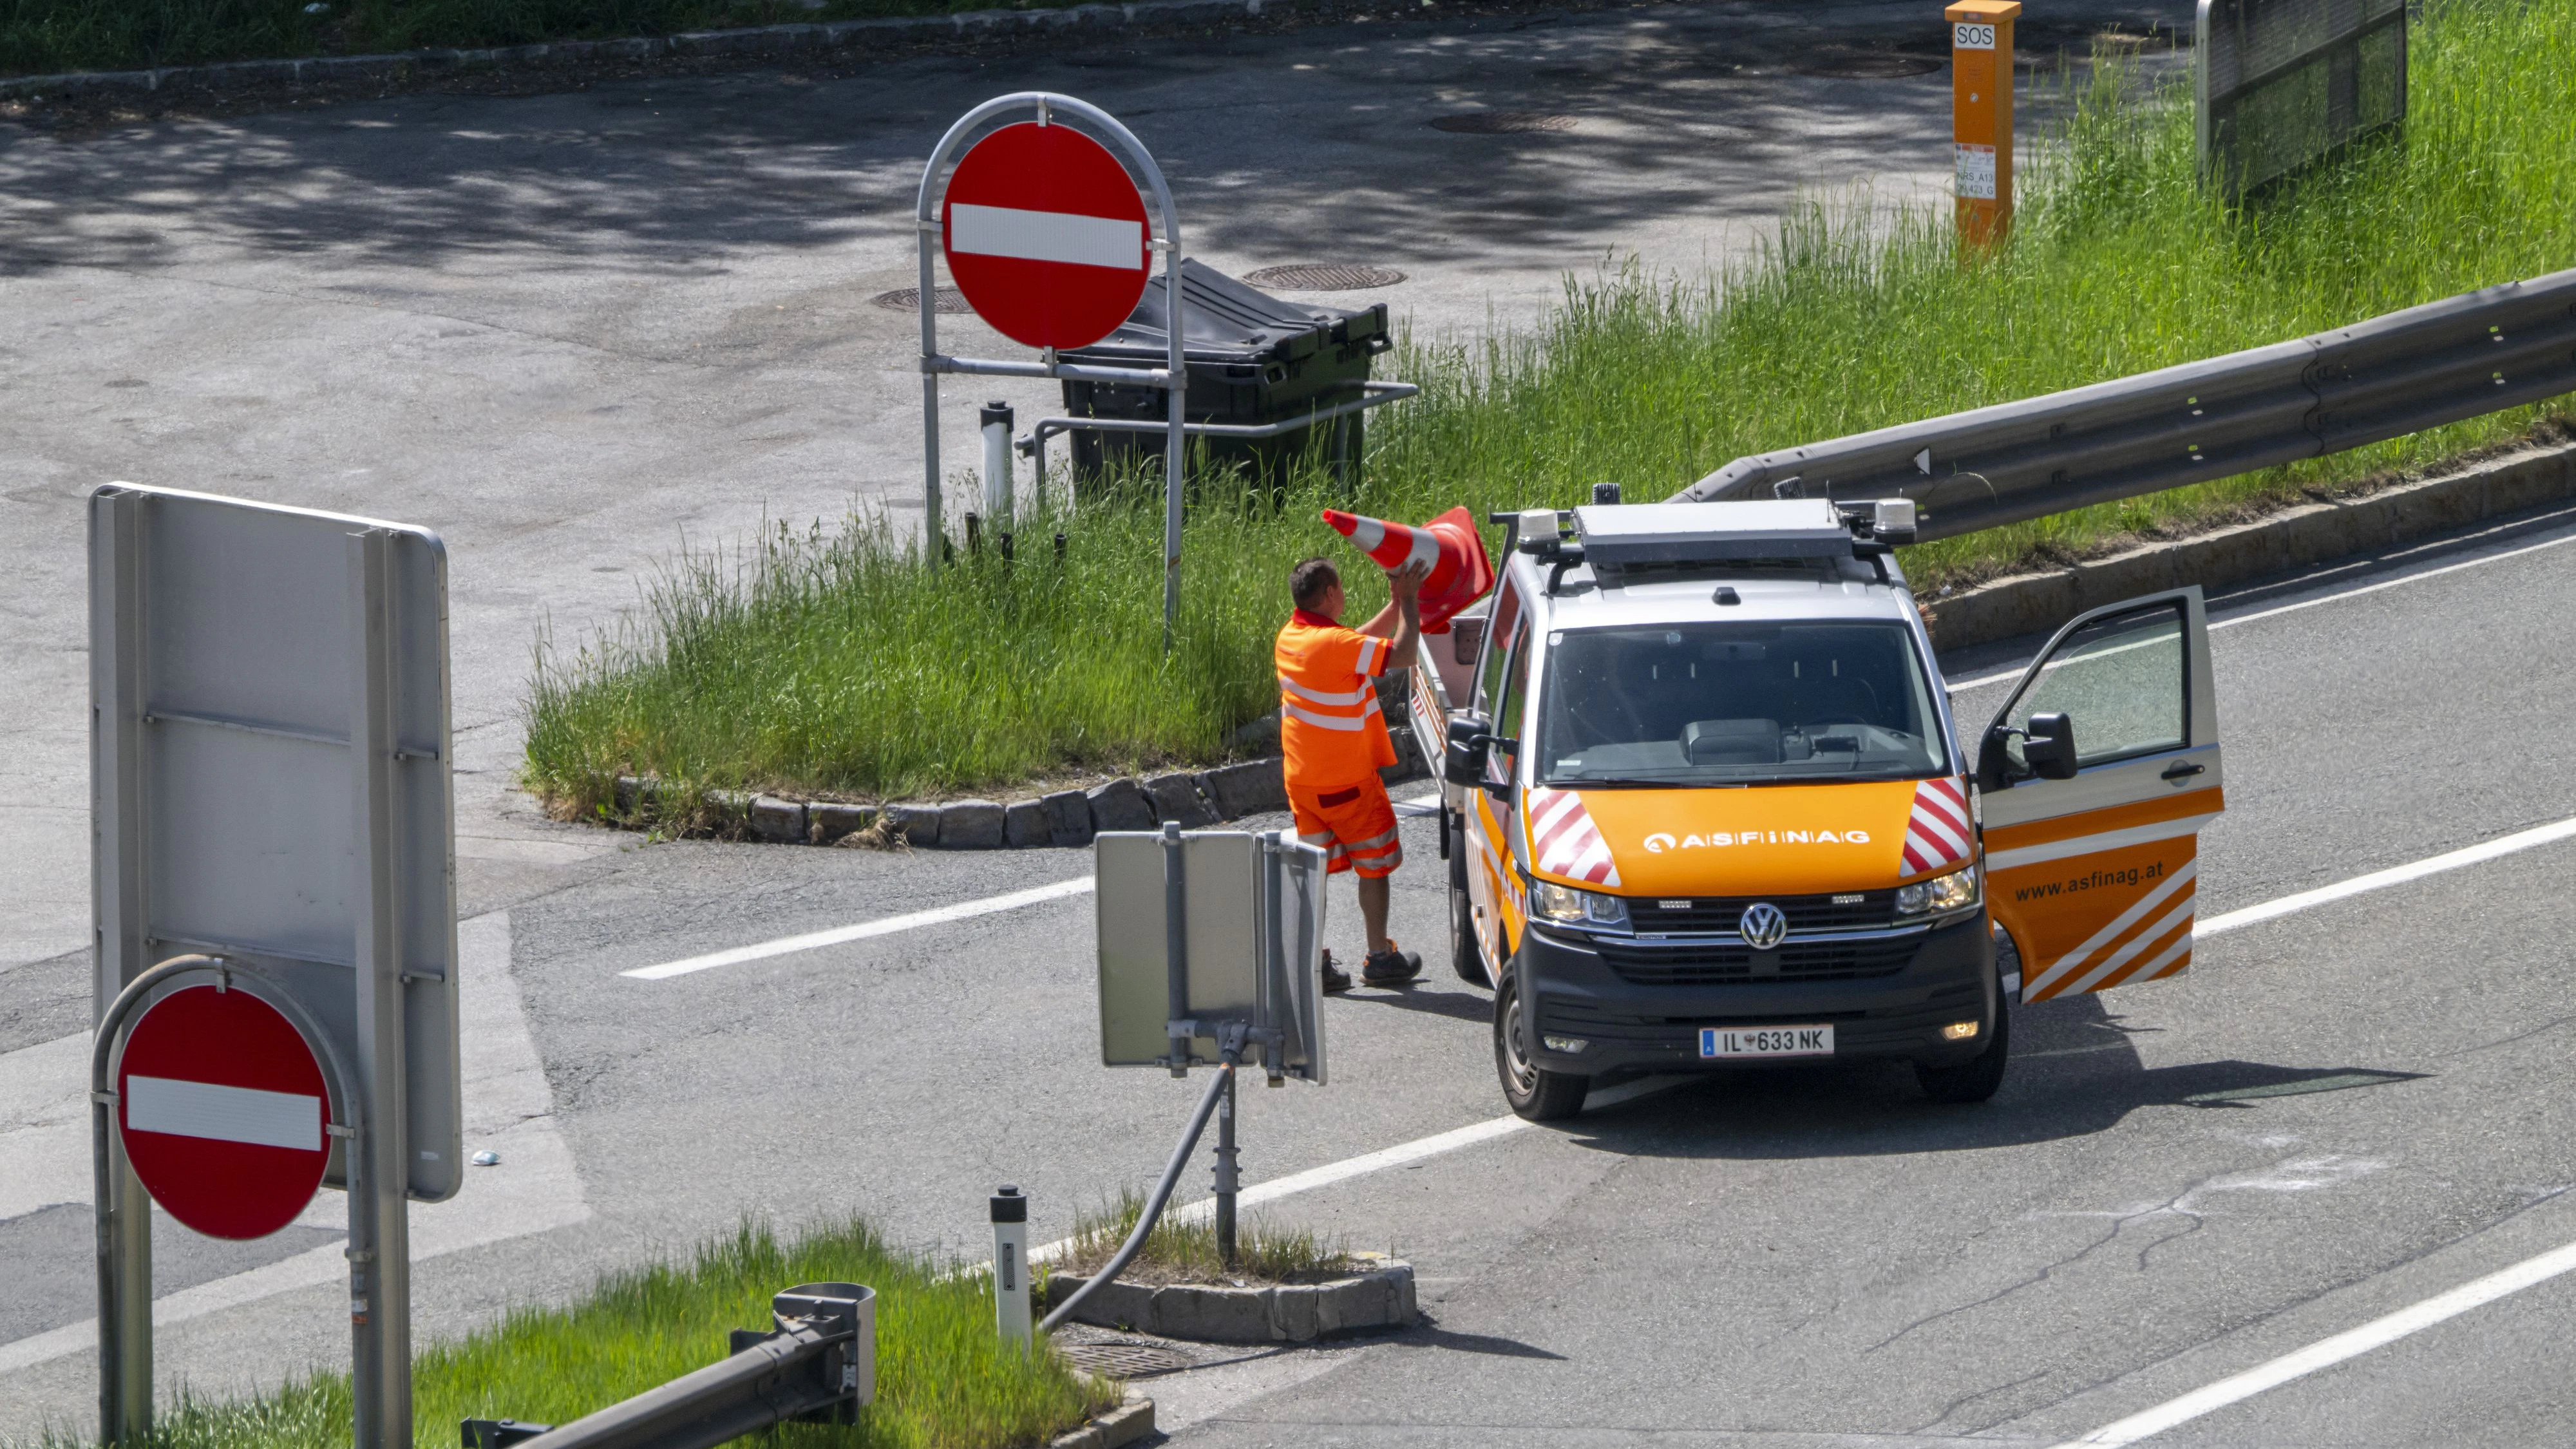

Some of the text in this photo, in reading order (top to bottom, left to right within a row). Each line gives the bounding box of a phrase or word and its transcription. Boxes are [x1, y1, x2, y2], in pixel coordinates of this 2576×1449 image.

[1957, 26, 1993, 45] SOS
[2015, 860, 2164, 902] www.asfinag.at
[1723, 1033, 1741, 1052] IL
[1757, 1031, 1794, 1051] 633
[1799, 1030, 1823, 1050] NK
